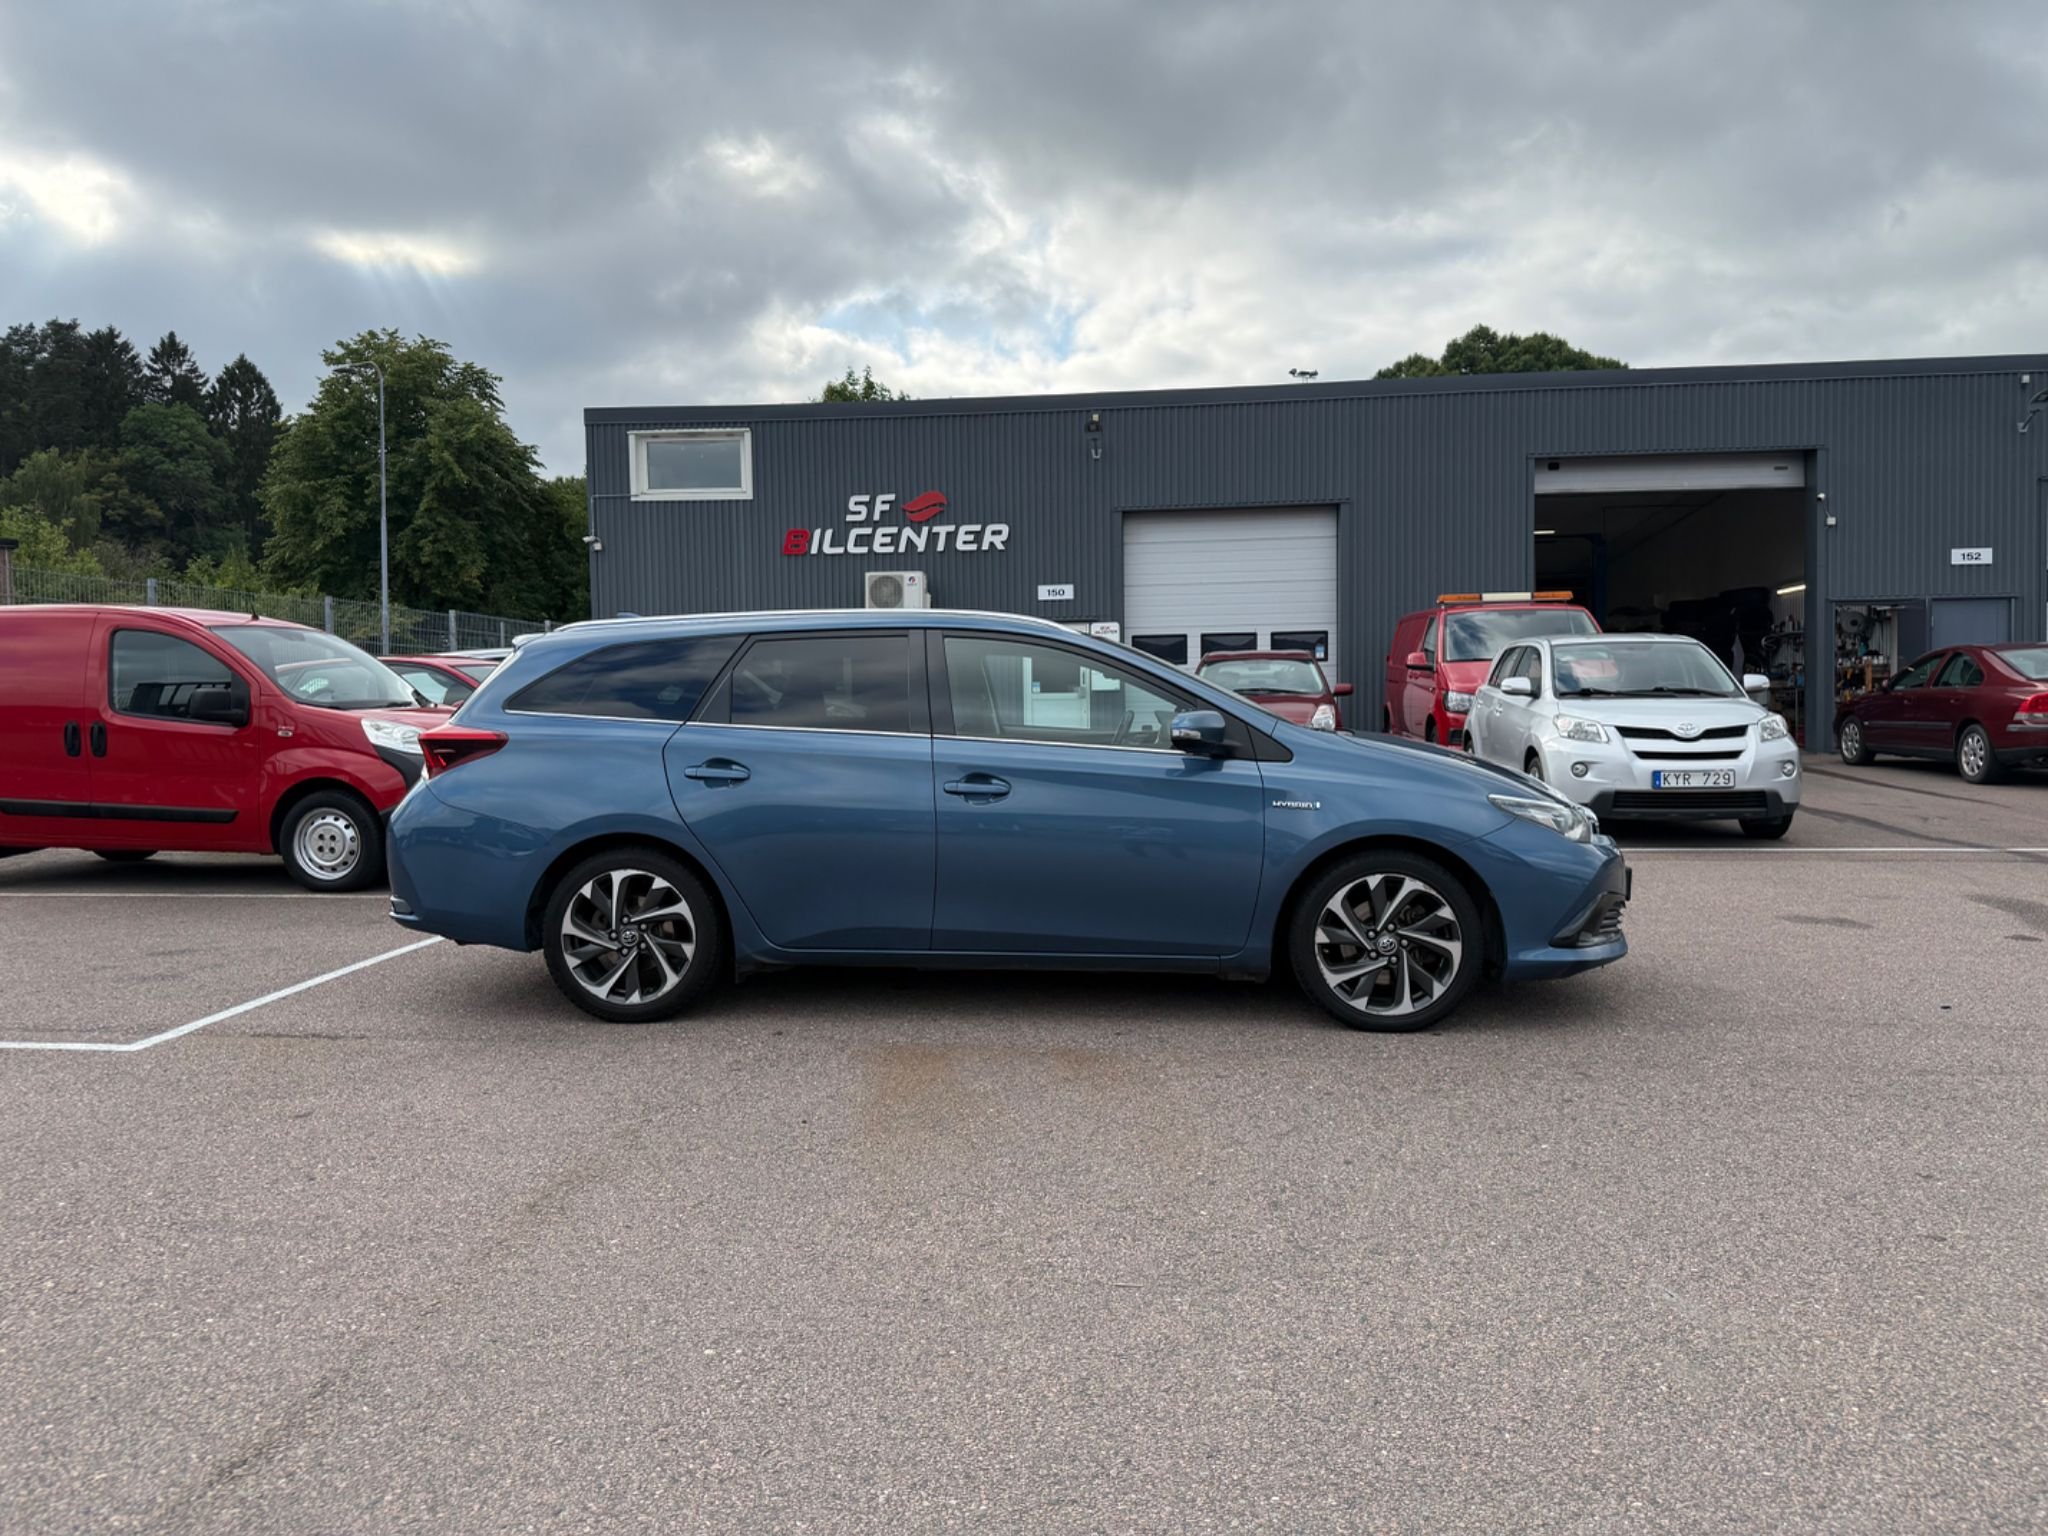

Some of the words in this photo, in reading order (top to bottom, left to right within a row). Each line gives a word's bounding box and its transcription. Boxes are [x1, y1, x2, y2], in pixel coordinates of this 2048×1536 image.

[846, 493, 895, 522] SF
[783, 523, 1009, 555] BILCENTER
[1961, 551, 1982, 561] 152
[1047, 588, 1065, 597] 150
[1663, 773, 1692, 785] KYR
[1703, 772, 1731, 785] 729
